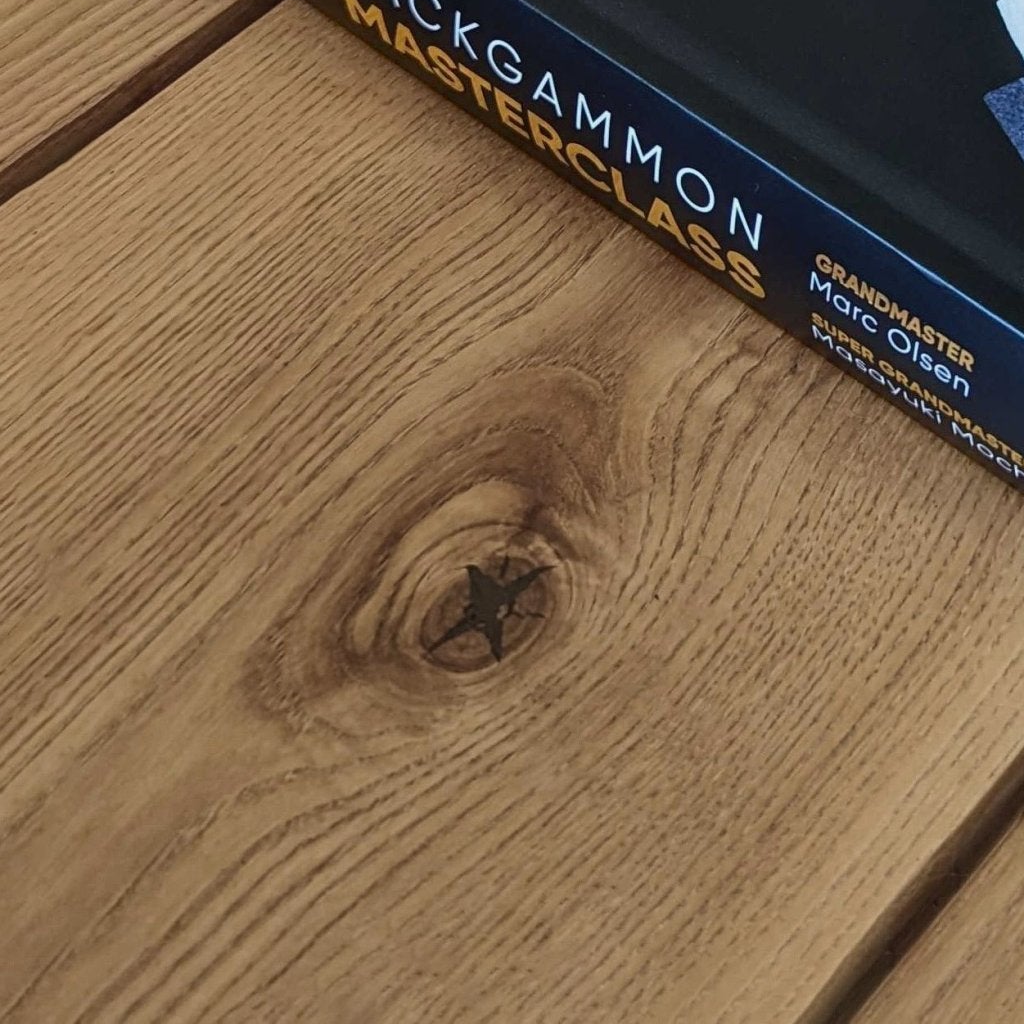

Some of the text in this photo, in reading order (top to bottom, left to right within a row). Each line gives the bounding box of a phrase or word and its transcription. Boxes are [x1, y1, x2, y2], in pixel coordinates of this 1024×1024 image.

[808, 270, 970, 397] Marc Olsen
[810, 312, 874, 363] SUPER
[814, 252, 975, 373] GRANDMASTER
[811, 324, 942, 426] Masayuki
